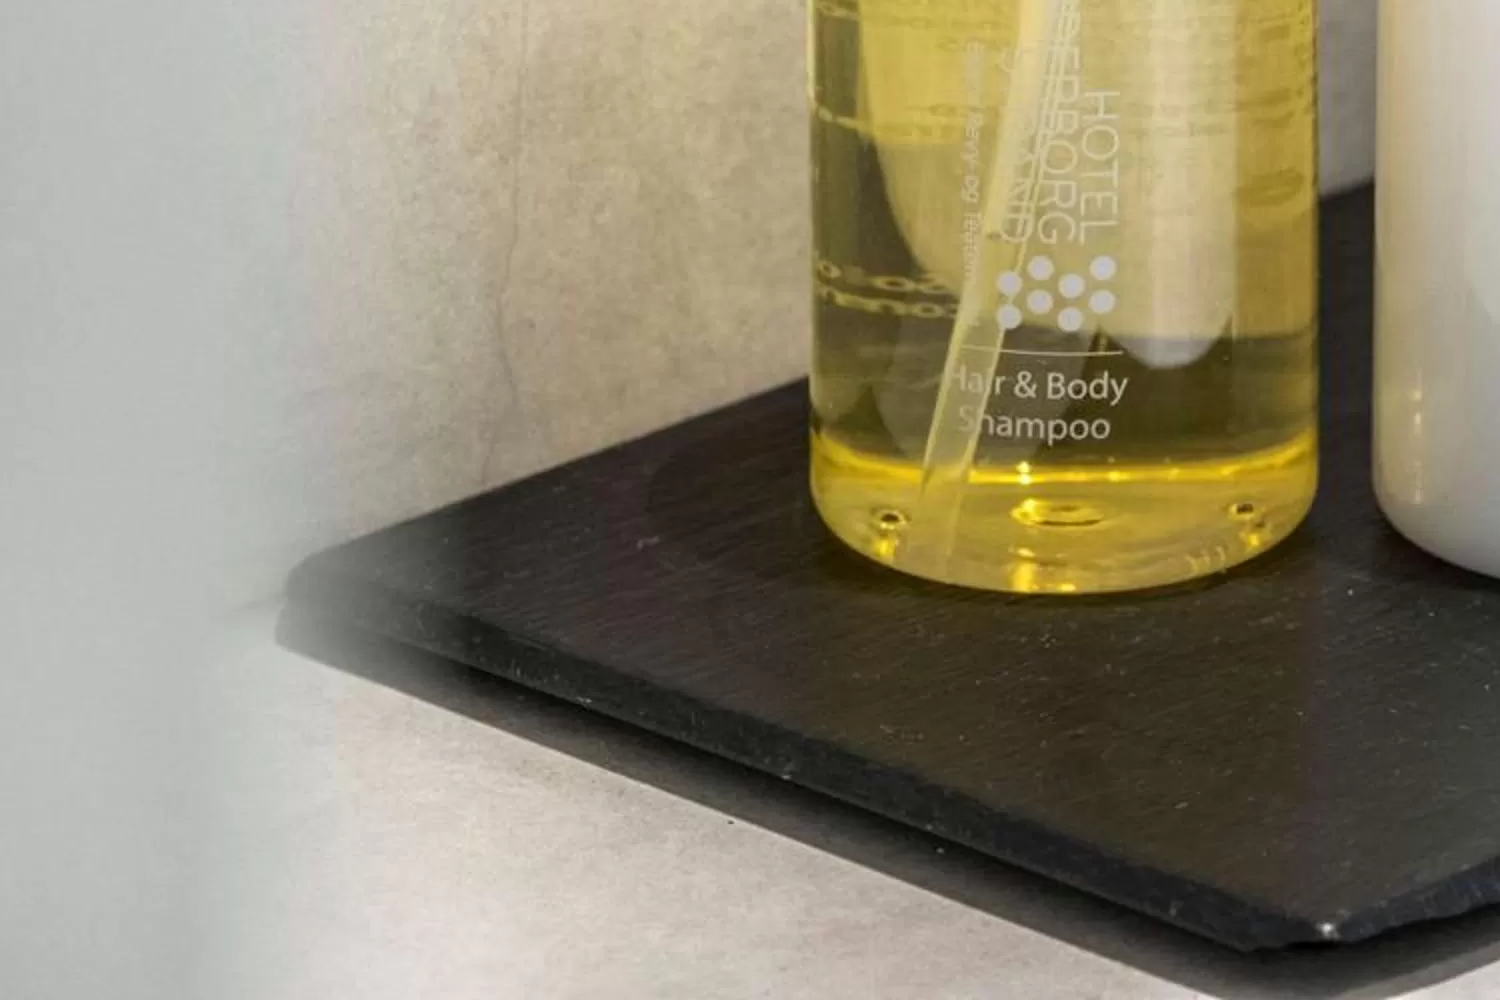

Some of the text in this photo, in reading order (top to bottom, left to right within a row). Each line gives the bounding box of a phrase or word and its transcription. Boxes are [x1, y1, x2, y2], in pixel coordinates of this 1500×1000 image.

[1078, 91, 1120, 246] HOTEL
[1013, 371, 1037, 399] &
[1047, 370, 1129, 406] Body
[958, 405, 1111, 446] Shampoo
